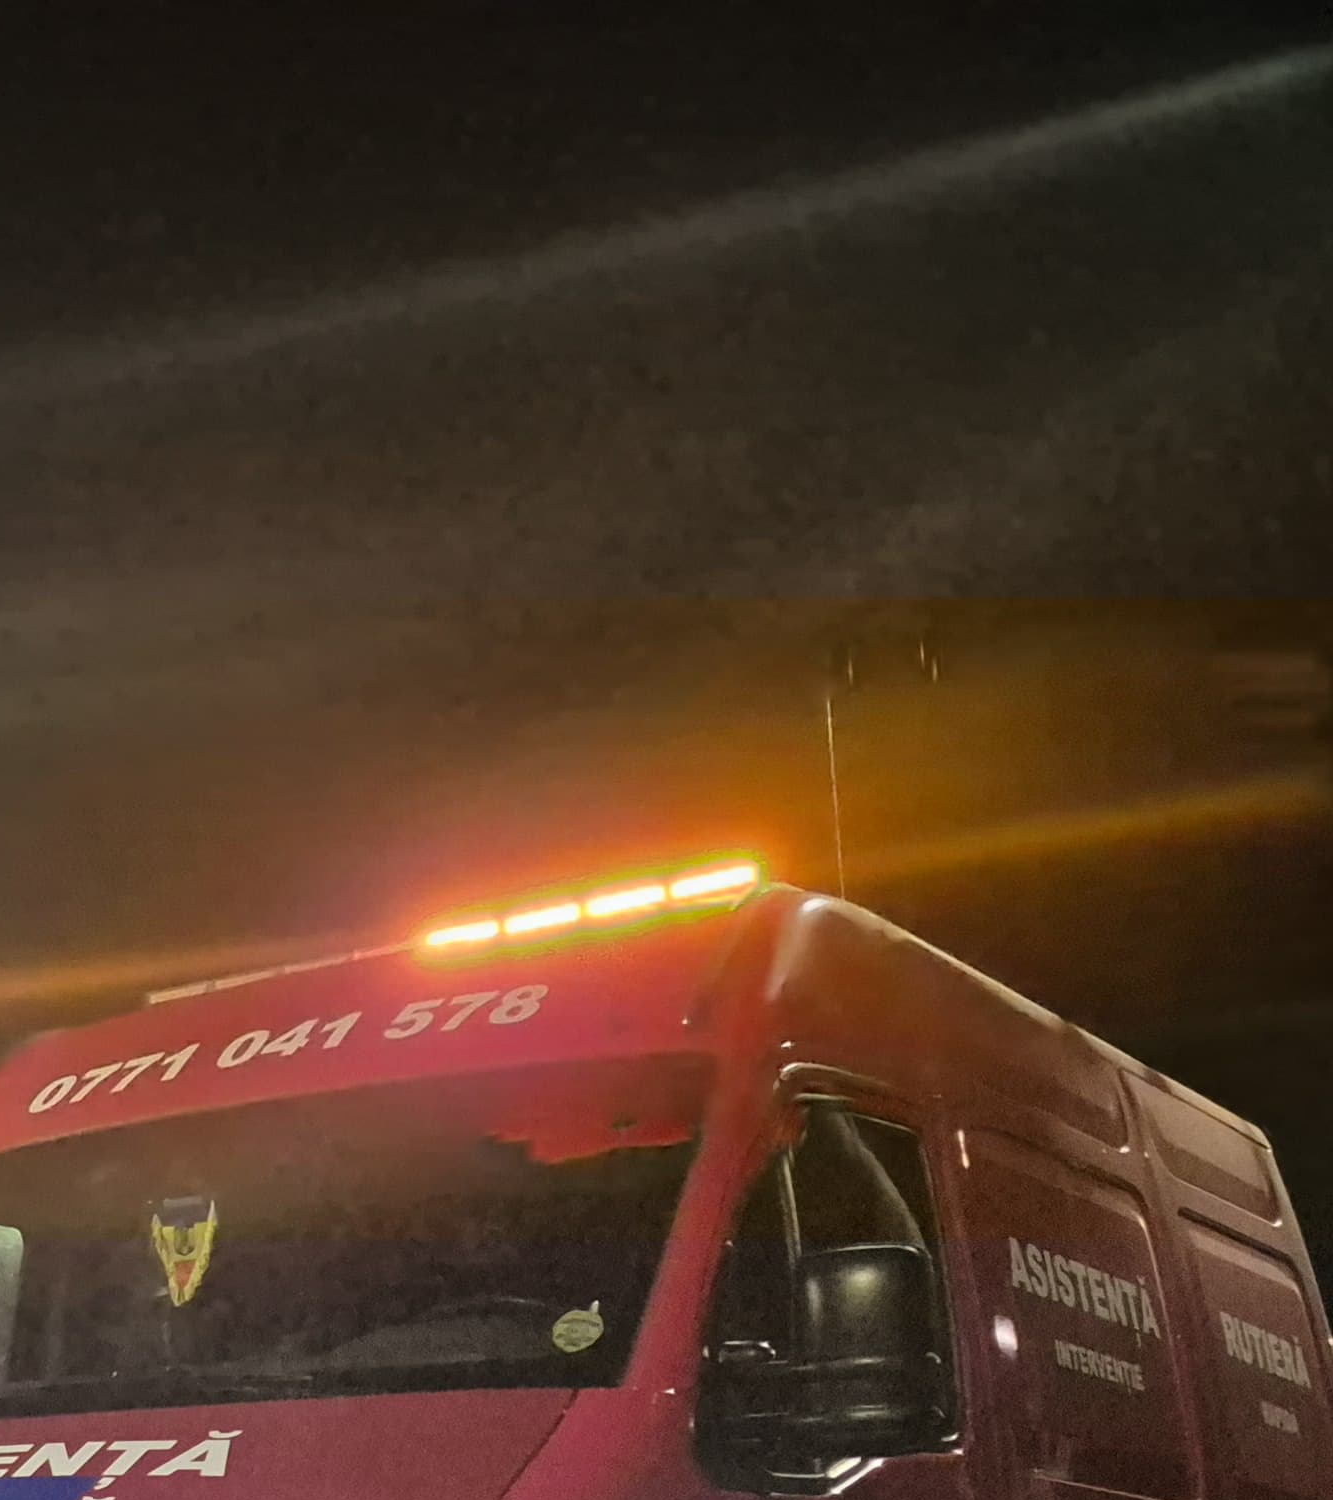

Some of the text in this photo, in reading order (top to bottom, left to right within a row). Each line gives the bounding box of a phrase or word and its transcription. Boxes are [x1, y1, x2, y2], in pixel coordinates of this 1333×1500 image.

[28, 985, 549, 1113] 0771 041 578
[1009, 1236, 1160, 1348] ASISTENȚĂ
[1220, 1311, 1311, 1388] RUTIERĂ
